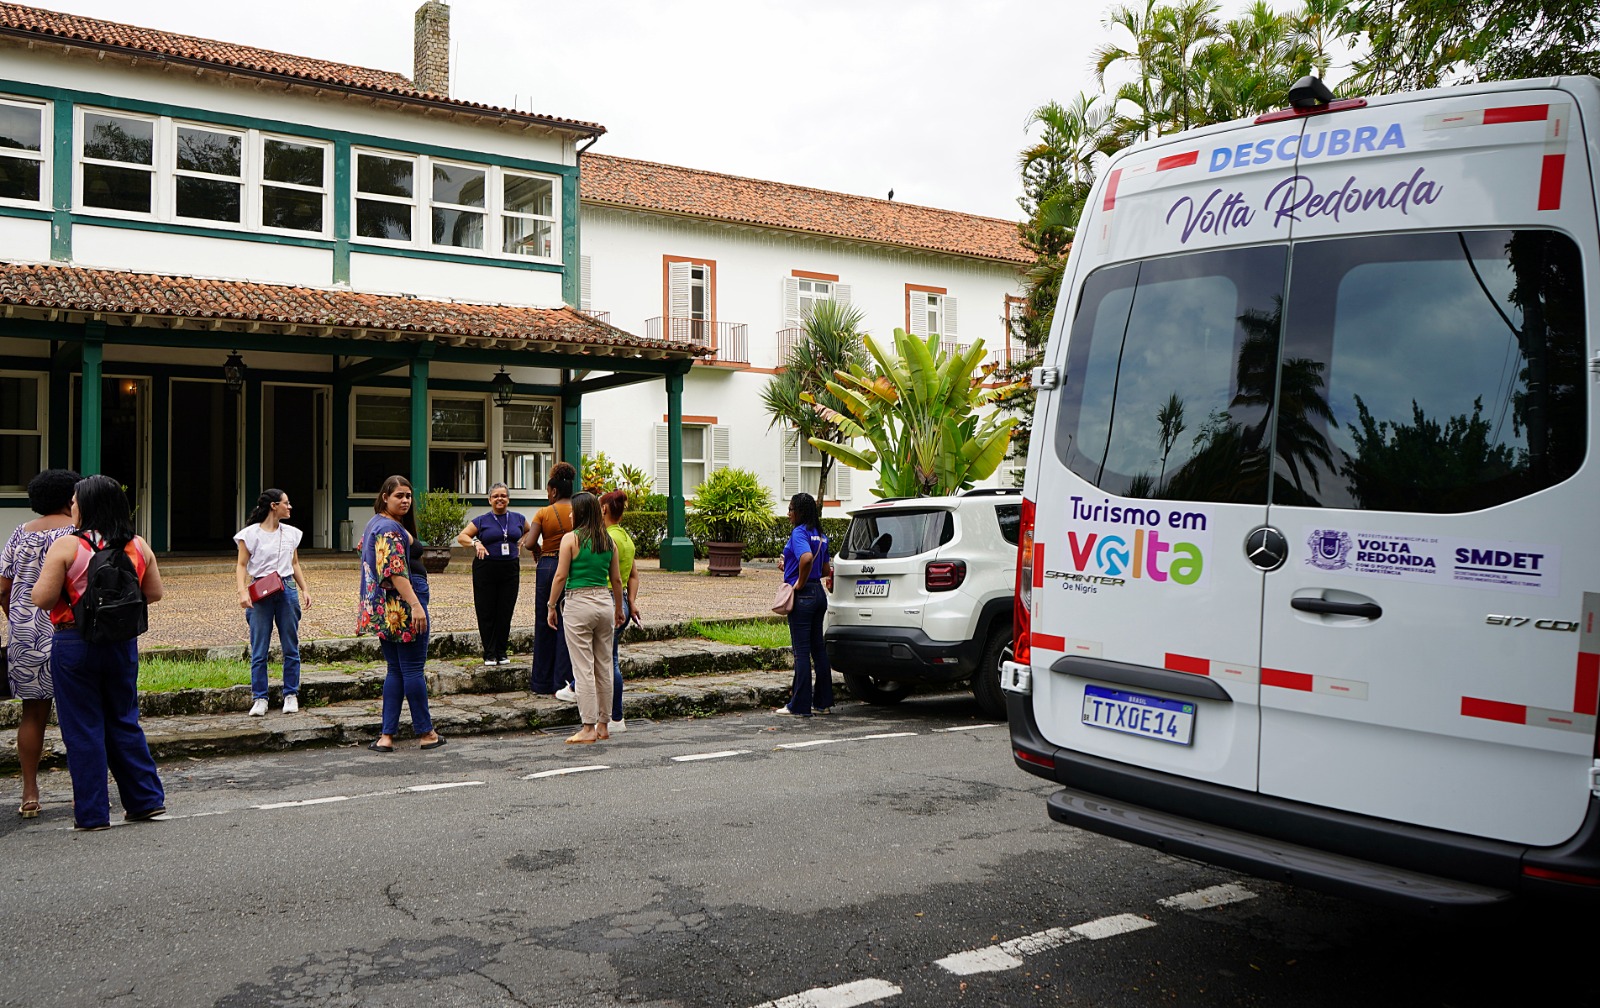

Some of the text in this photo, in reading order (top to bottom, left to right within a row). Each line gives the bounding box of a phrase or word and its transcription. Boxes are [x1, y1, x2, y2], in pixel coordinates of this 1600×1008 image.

[1208, 123, 1406, 172] DESCUBRA
[1166, 166, 1443, 244] Volta Redonda
[1070, 496, 1207, 531] Turismo em
[1358, 539, 1411, 554] VOLTA
[1356, 551, 1436, 568] REDONDA
[1454, 547, 1544, 570] SMDET
[1044, 570, 1125, 587] SPRINTER
[1394, 566, 1436, 575] HONESTIDADE
[1075, 584, 1097, 594] Nigris
[1486, 613, 1530, 628] 517
[1534, 618, 1580, 633] CDI
[1128, 695, 1147, 705] BRASIL
[1092, 699, 1177, 738] TTX0E14
